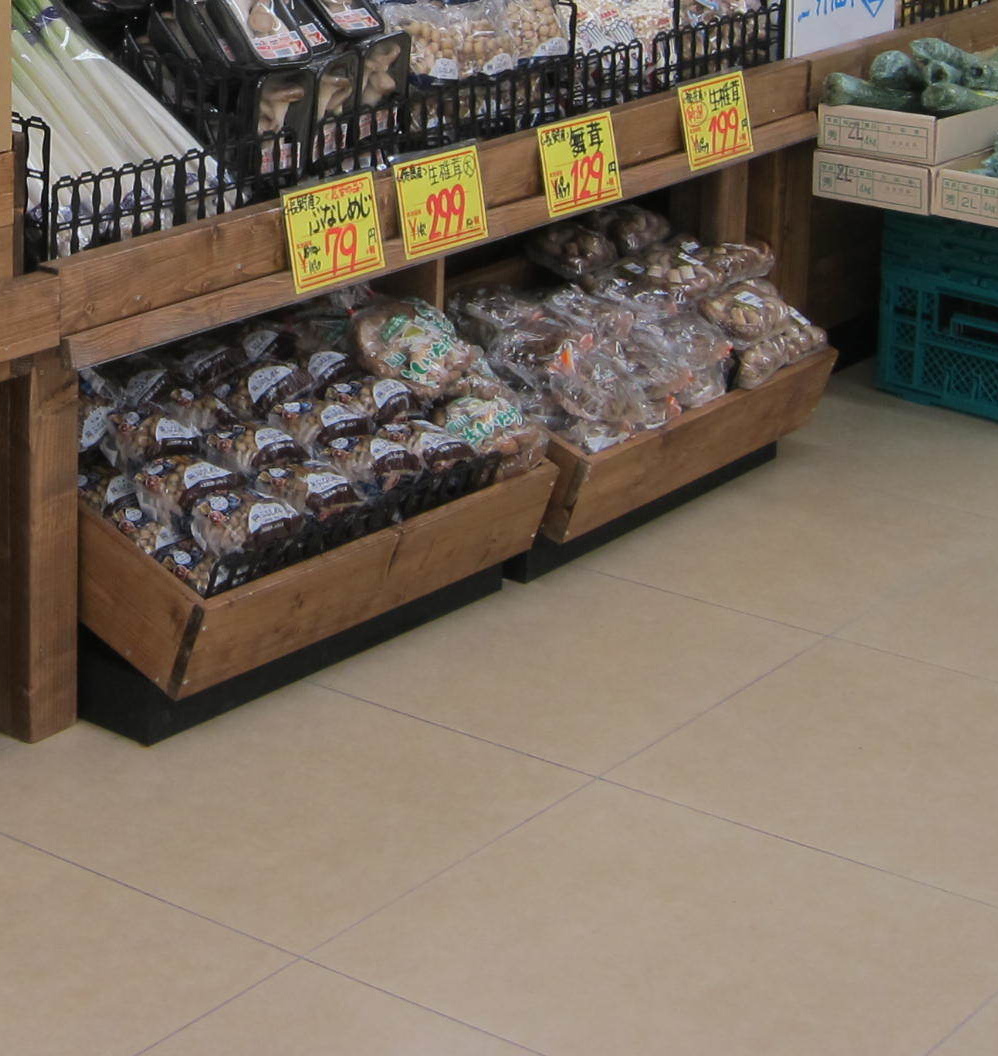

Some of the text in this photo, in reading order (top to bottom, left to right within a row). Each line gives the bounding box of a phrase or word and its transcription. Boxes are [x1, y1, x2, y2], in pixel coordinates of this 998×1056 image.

[708, 107, 738, 154] 199
[571, 152, 603, 205] 129
[309, 193, 371, 236] ぶなしめじ
[325, 223, 357, 275] 79
